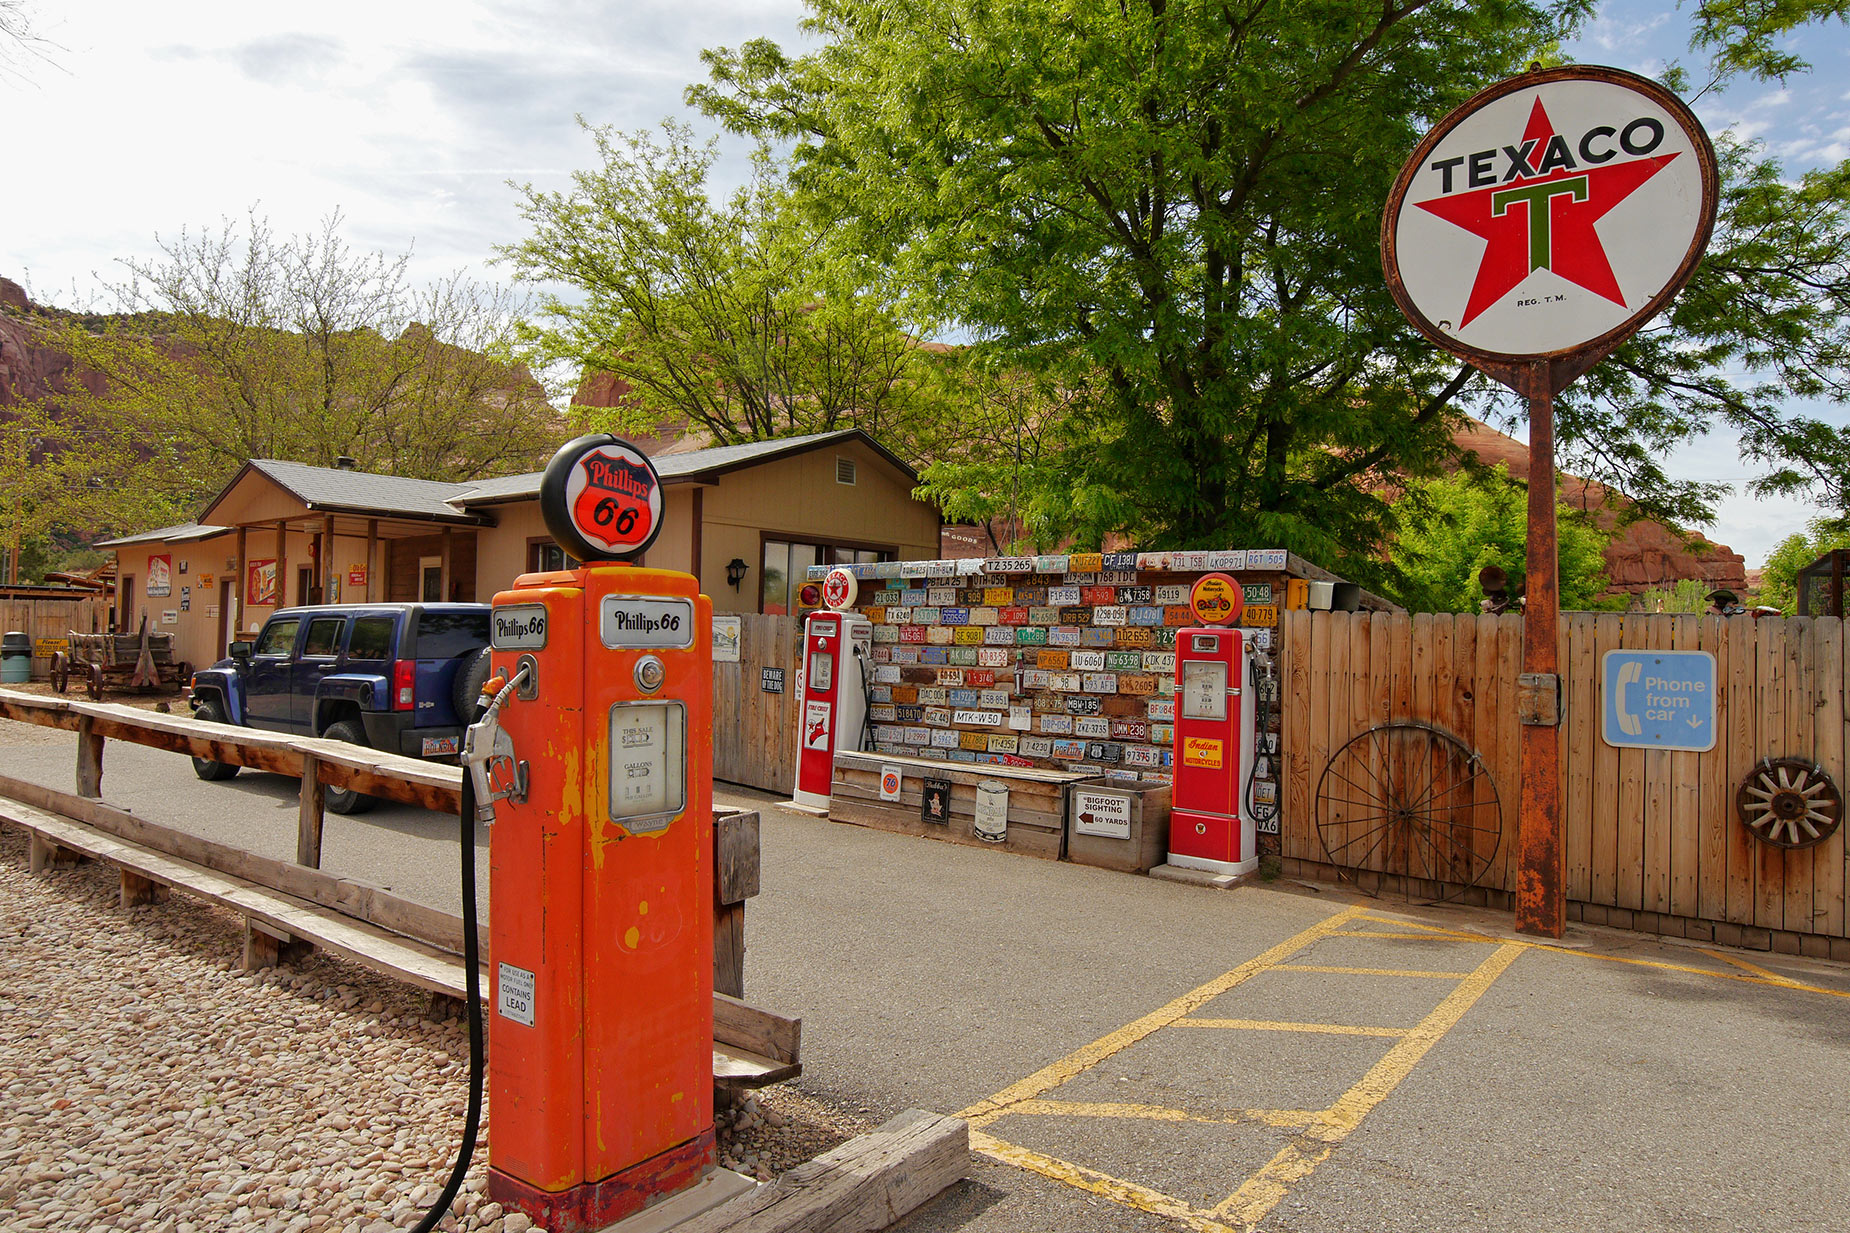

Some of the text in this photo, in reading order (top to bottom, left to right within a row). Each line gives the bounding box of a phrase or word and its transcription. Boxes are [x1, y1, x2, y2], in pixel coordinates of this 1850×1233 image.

[1431, 117, 1665, 194] TEXACO
[1491, 174, 1589, 275] T
[1517, 299, 1541, 308] REG.
[589, 460, 649, 501] Phillips
[593, 496, 639, 535] 66
[951, 534, 978, 545] GOODS
[1104, 556, 1117, 566] CF
[1117, 554, 1135, 566] 1381
[1248, 554, 1284, 565] RGT 505
[987, 560, 1000, 571] TZ
[1003, 560, 1013, 570] 35
[1014, 560, 1031, 570] 265
[826, 571, 848, 586] TEXACO
[950, 577, 961, 587] 25
[1133, 591, 1151, 601] 7358
[1161, 590, 1180, 600] 9119
[825, 596, 846, 608] ETHYL
[614, 610, 681, 634] Phillips 66
[496, 616, 545, 640] Phillips 66
[763, 669, 782, 680] BEWARE
[774, 681, 783, 692] DOG
[1061, 677, 1069, 689] 98
[1645, 677, 1706, 692] Phone
[1646, 693, 1690, 708] from
[988, 714, 998, 724] 50
[1645, 709, 1676, 721] car
[1130, 725, 1145, 736] 238
[1188, 740, 1218, 751] Indian
[624, 761, 653, 770] GALLONS
[1185, 757, 1221, 767] MOTORCYCLES
[885, 778, 897, 788] 76
[1084, 804, 1123, 814] SIGHTING
[1094, 816, 1128, 826] 60 YARDS
[500, 974, 534, 989] MOTOR FUEL ONLY
[502, 984, 531, 1001] CONTAINS
[506, 996, 527, 1013] LEAD
